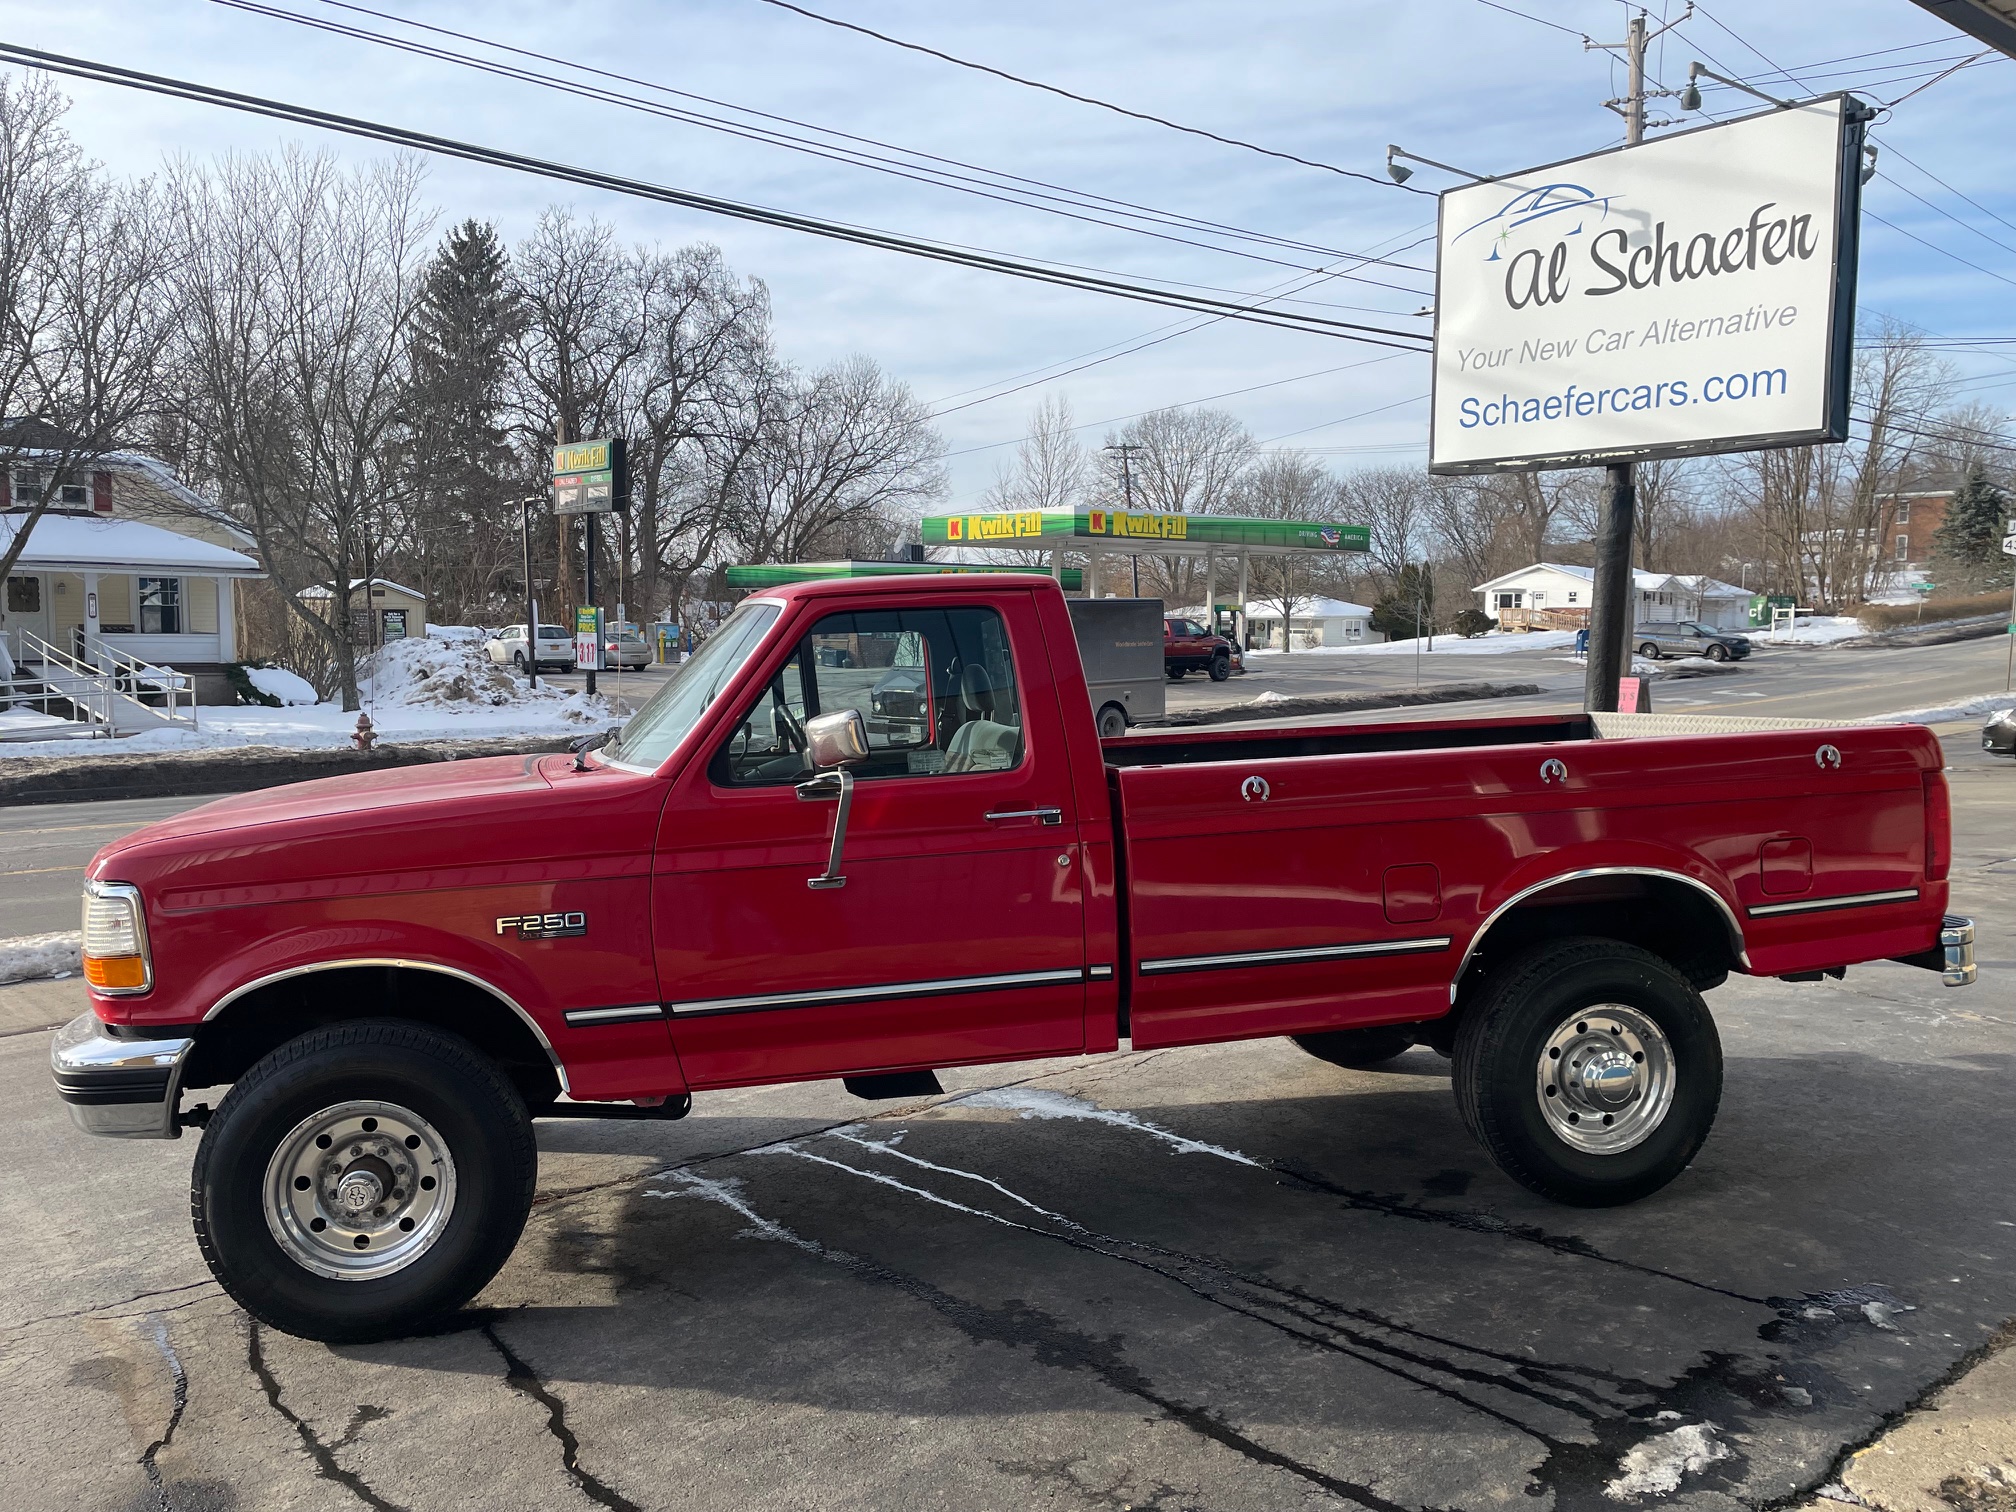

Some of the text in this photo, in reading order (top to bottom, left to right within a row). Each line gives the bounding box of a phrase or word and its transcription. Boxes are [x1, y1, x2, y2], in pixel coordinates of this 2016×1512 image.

[1505, 203, 1819, 310] Al Schaefer
[1458, 304, 1798, 372] Your New Car Alternative
[1459, 368, 1788, 428] Schaefercars.com
[1299, 530, 1318, 538] DRIVING
